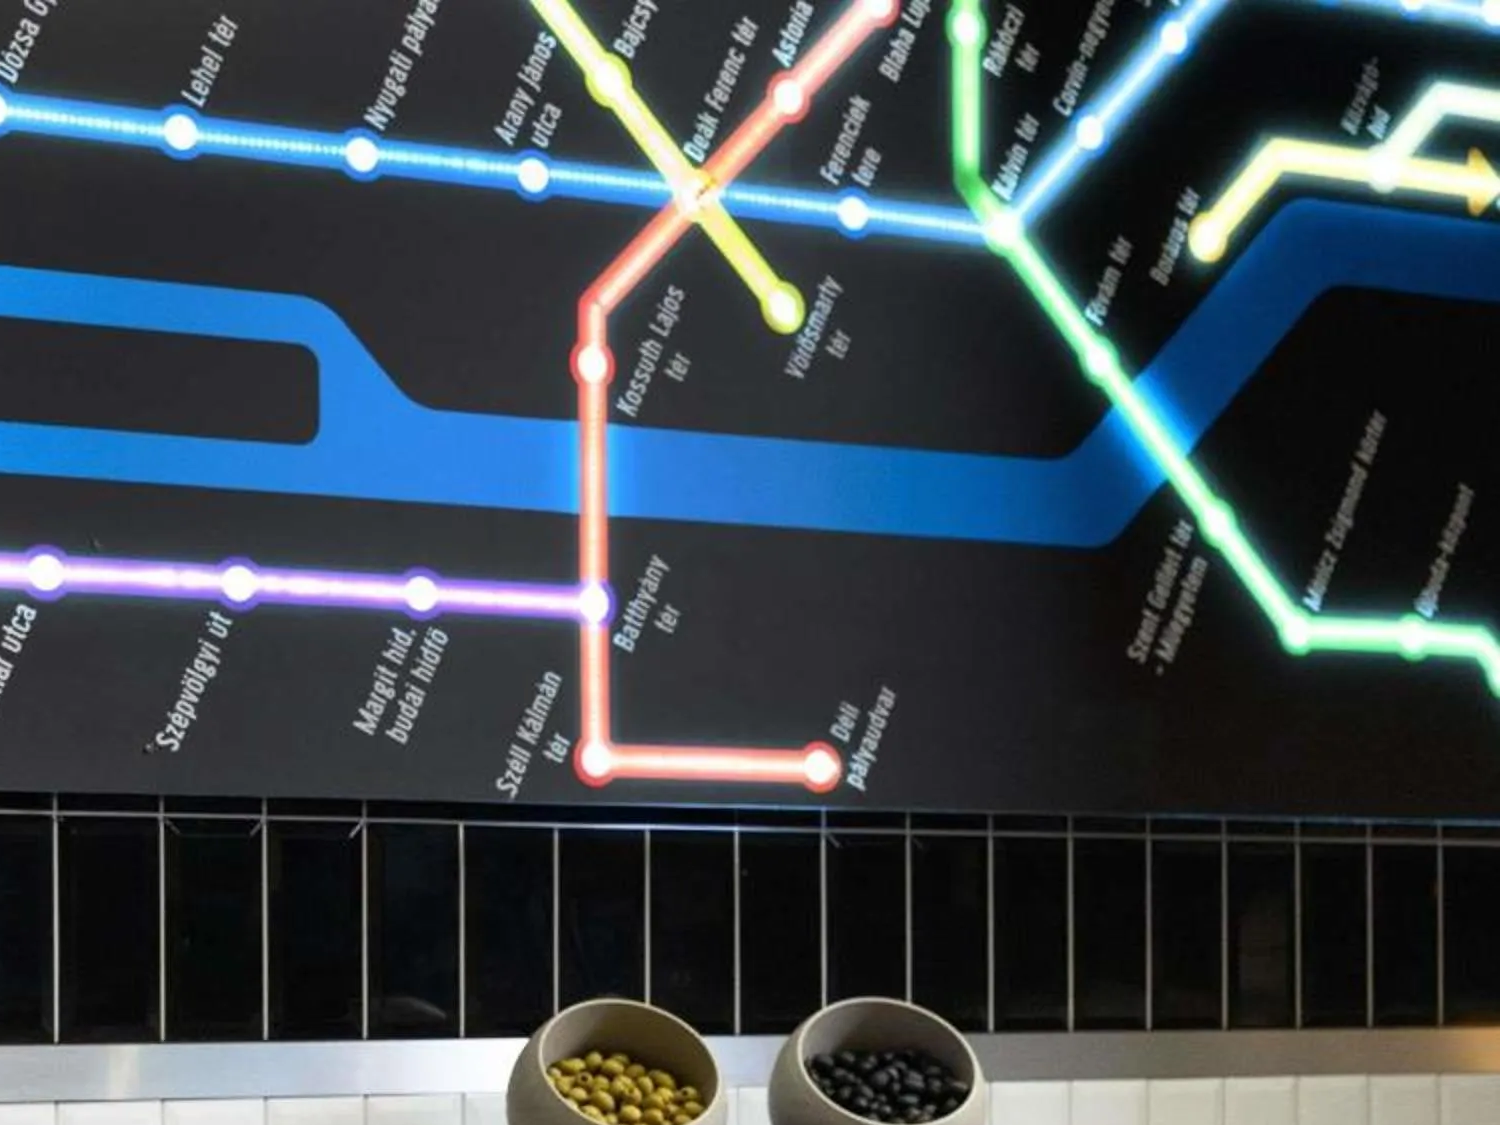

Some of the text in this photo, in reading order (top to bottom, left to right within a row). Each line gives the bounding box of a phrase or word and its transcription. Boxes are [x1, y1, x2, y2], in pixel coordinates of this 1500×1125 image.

[180, 14, 241, 108] Lehel tér
[363, 0, 441, 132] Nyugati pálya
[705, 46, 746, 114] Ferenc
[731, 15, 759, 48] tér
[772, 0, 814, 68] Astoria
[878, 27, 916, 83] Blaha
[982, 3, 1025, 78] Rákóczi
[493, 30, 557, 148] Arany János
[530, 102, 563, 149] utca
[820, 94, 872, 186] Ferenciek
[1014, 112, 1040, 143] tér
[851, 147, 882, 188] tere
[616, 284, 685, 418] Kossuth Lajos
[664, 352, 691, 382] tér
[825, 329, 851, 360] tér
[1, 603, 37, 653] utca
[613, 554, 670, 653] Batthyány
[654, 604, 681, 634] tér
[155, 638, 221, 752] Szépvölgyi
[353, 664, 397, 736] Margit
[386, 682, 426, 744] budai
[495, 670, 562, 801] Széll Kálmán
[542, 732, 571, 763] tér
